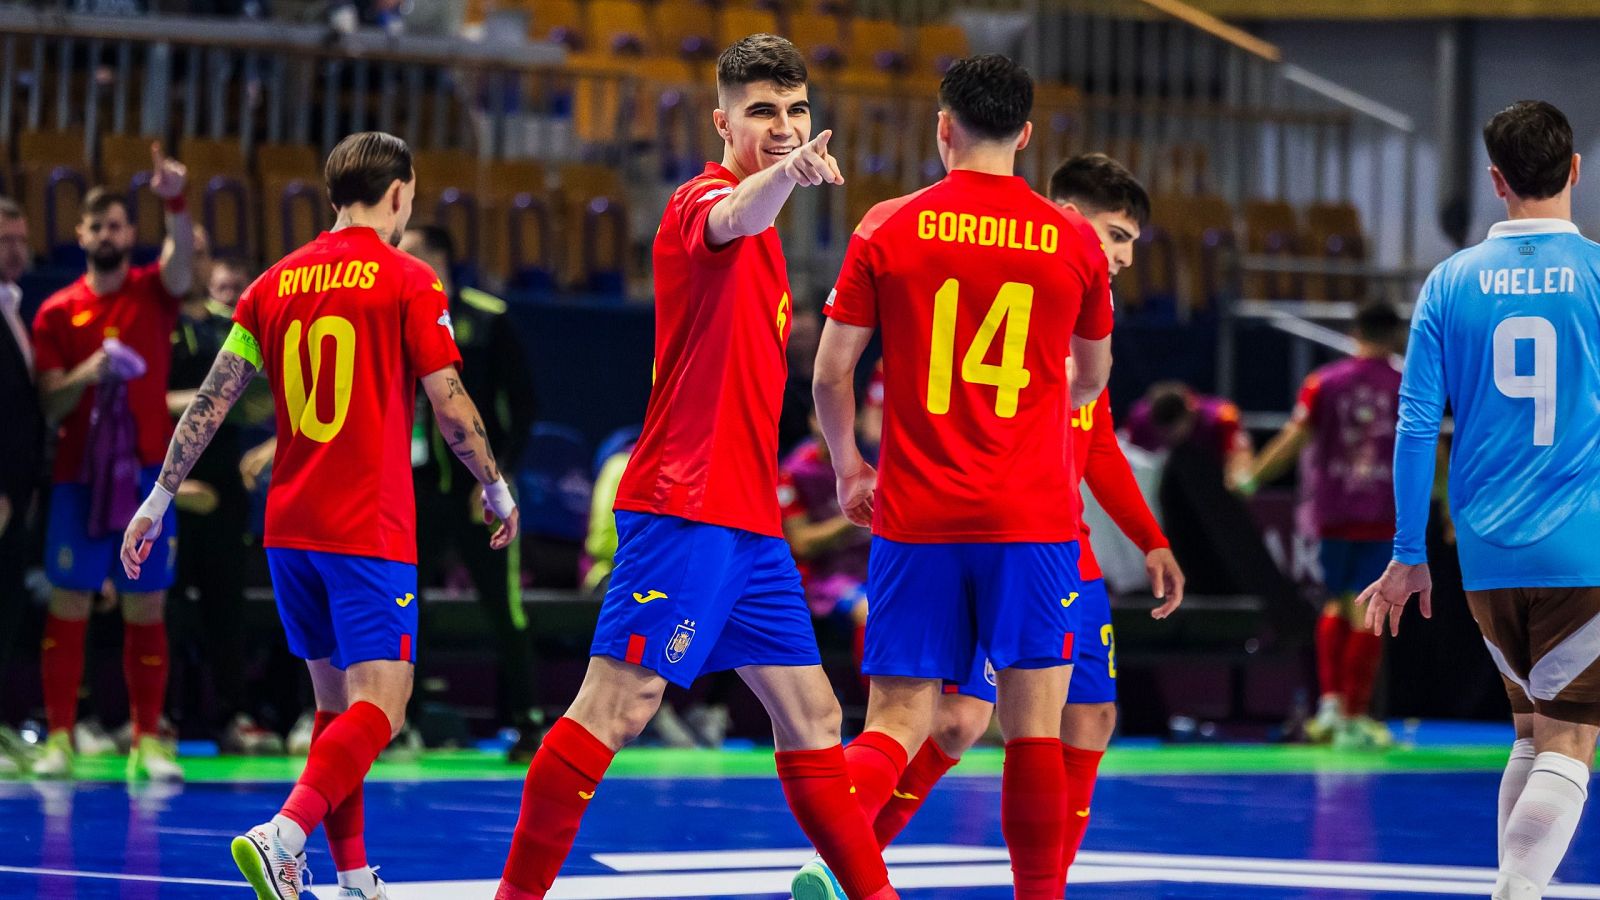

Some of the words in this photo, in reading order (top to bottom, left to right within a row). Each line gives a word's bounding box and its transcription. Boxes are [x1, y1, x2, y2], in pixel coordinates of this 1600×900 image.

[918, 210, 1058, 254] GORDILLO
[278, 260, 379, 297] RIVILLOS
[1479, 266, 1575, 295] VAELEN
[927, 278, 1034, 418] 14
[283, 316, 356, 443] 10
[1493, 316, 1557, 447] 9
[1071, 399, 1097, 431] 0
